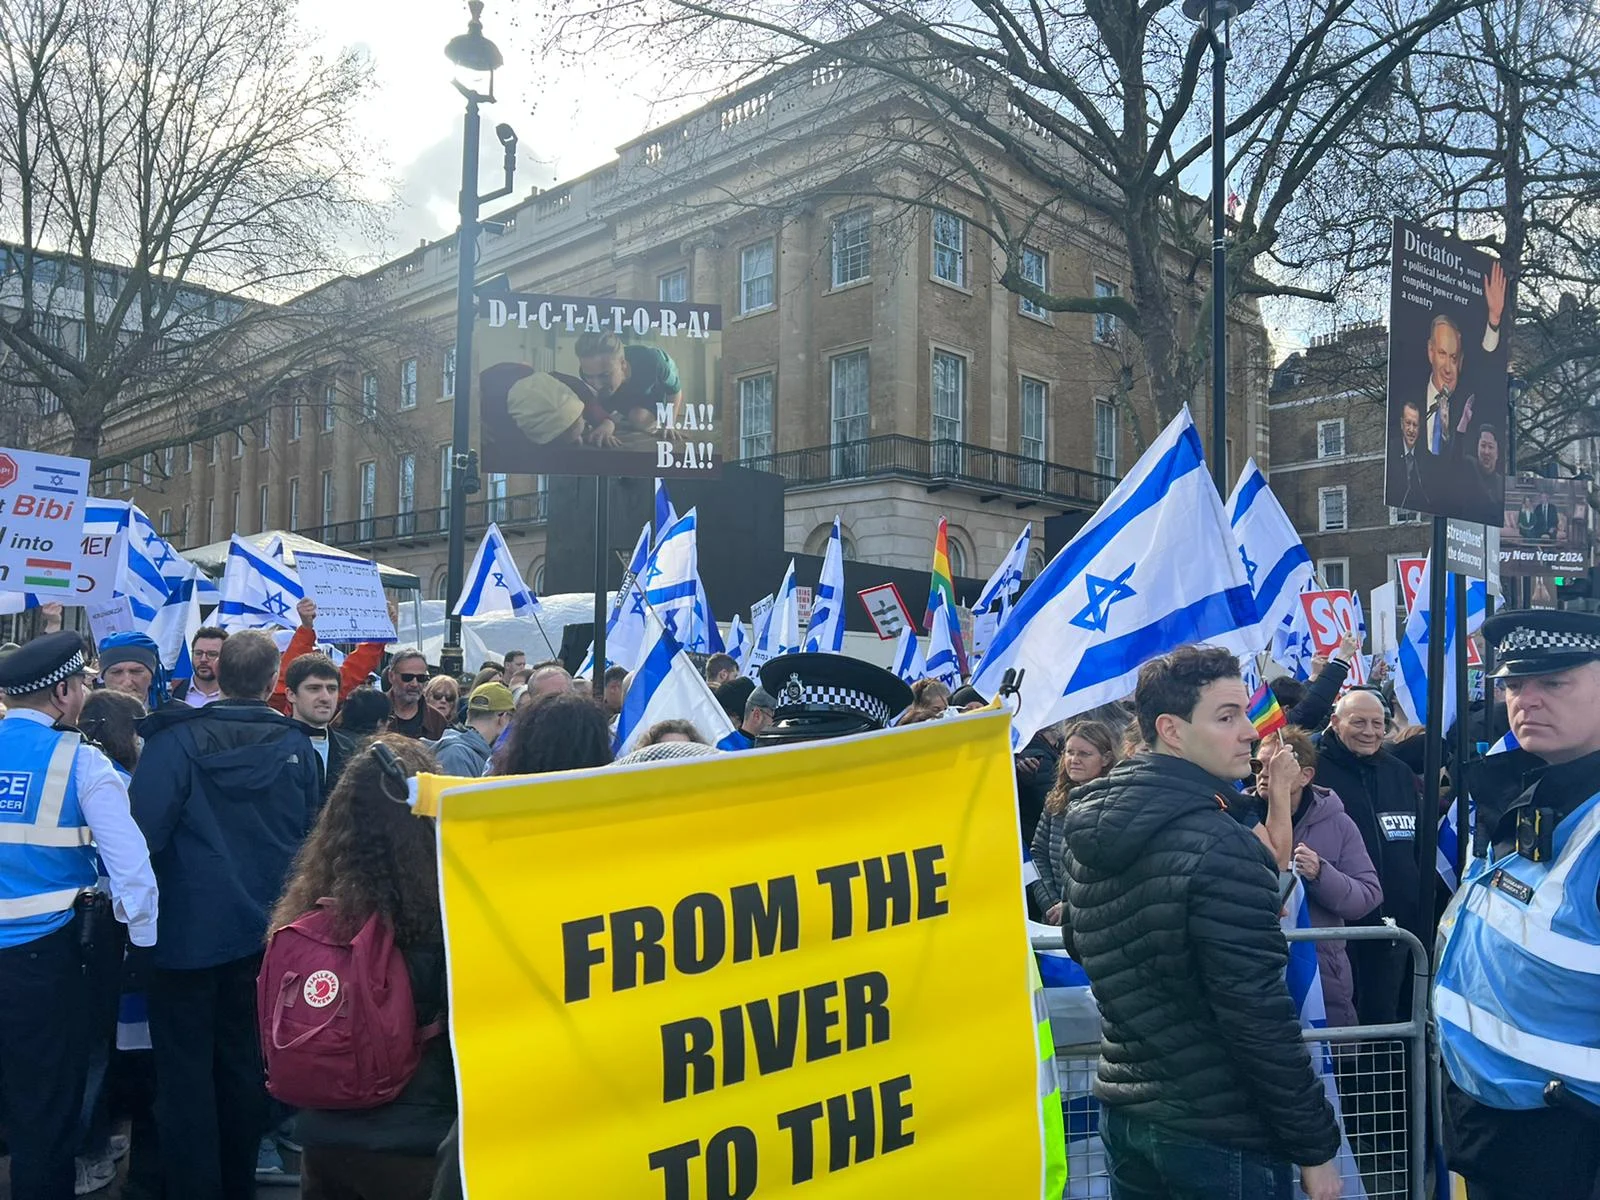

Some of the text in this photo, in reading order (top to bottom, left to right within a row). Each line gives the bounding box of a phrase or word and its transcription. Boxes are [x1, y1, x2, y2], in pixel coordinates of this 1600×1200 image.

[1404, 229, 1463, 276] Dictator,
[1402, 275, 1468, 305] complete power over
[1408, 261, 1435, 278] political
[1436, 269, 1456, 285] leader
[1457, 280, 1471, 291] who
[1471, 283, 1483, 296] has
[1407, 293, 1433, 310] country
[488, 299, 710, 339] D-I-C-T-A-T-O-R-A!
[655, 402, 714, 431] M.A!!
[656, 441, 714, 470] B.A!!
[12, 494, 74, 521] Bibi
[10, 533, 53, 552] into
[1512, 551, 1534, 561] New
[1536, 551, 1557, 562] Year
[1559, 552, 1583, 562] 2024
[561, 844, 949, 1004] FROM THE
[660, 971, 890, 1104] RIVER
[648, 1074, 915, 1200] TO THE
